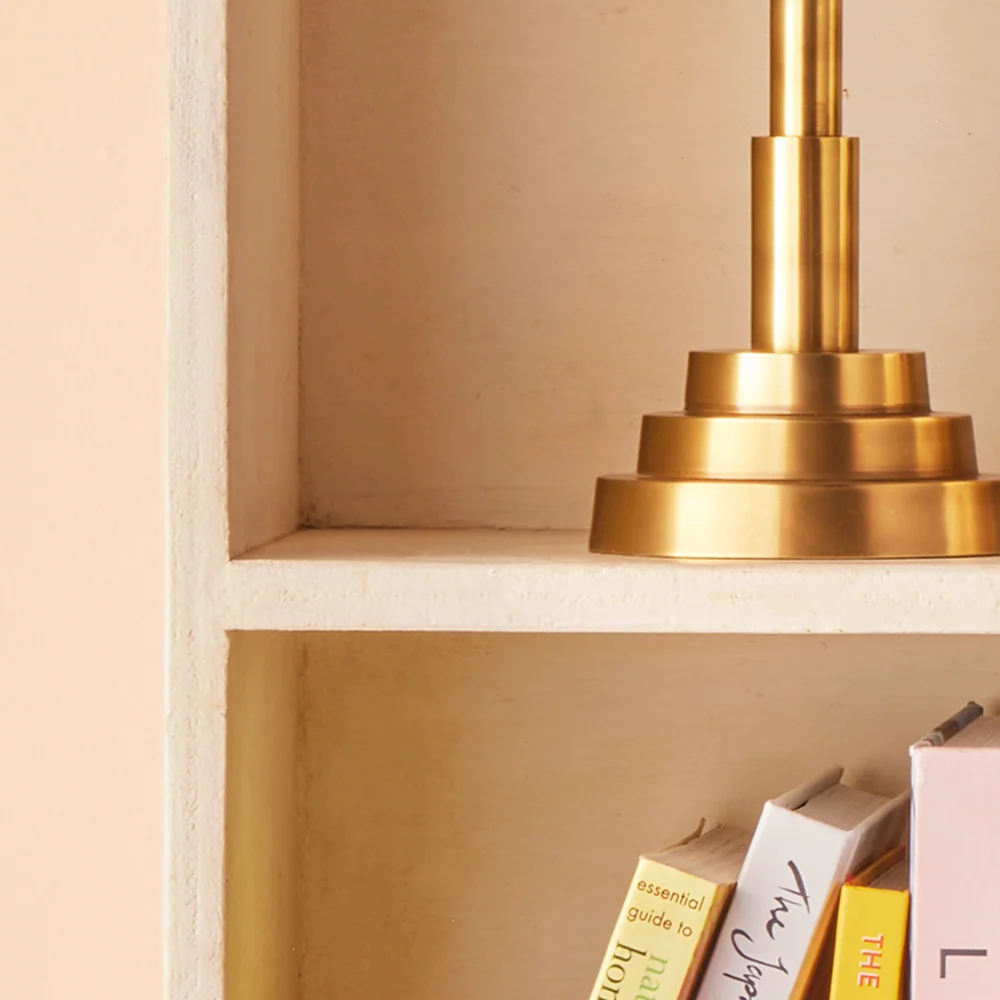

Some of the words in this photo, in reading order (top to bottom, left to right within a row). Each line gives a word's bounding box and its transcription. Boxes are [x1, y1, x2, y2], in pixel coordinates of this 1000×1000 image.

[626, 906, 673, 931] guide
[677, 921, 693, 937] to
[637, 880, 705, 912] essential
[766, 860, 811, 940] The
[722, 928, 789, 1000] Jap
[857, 933, 884, 988] THE
